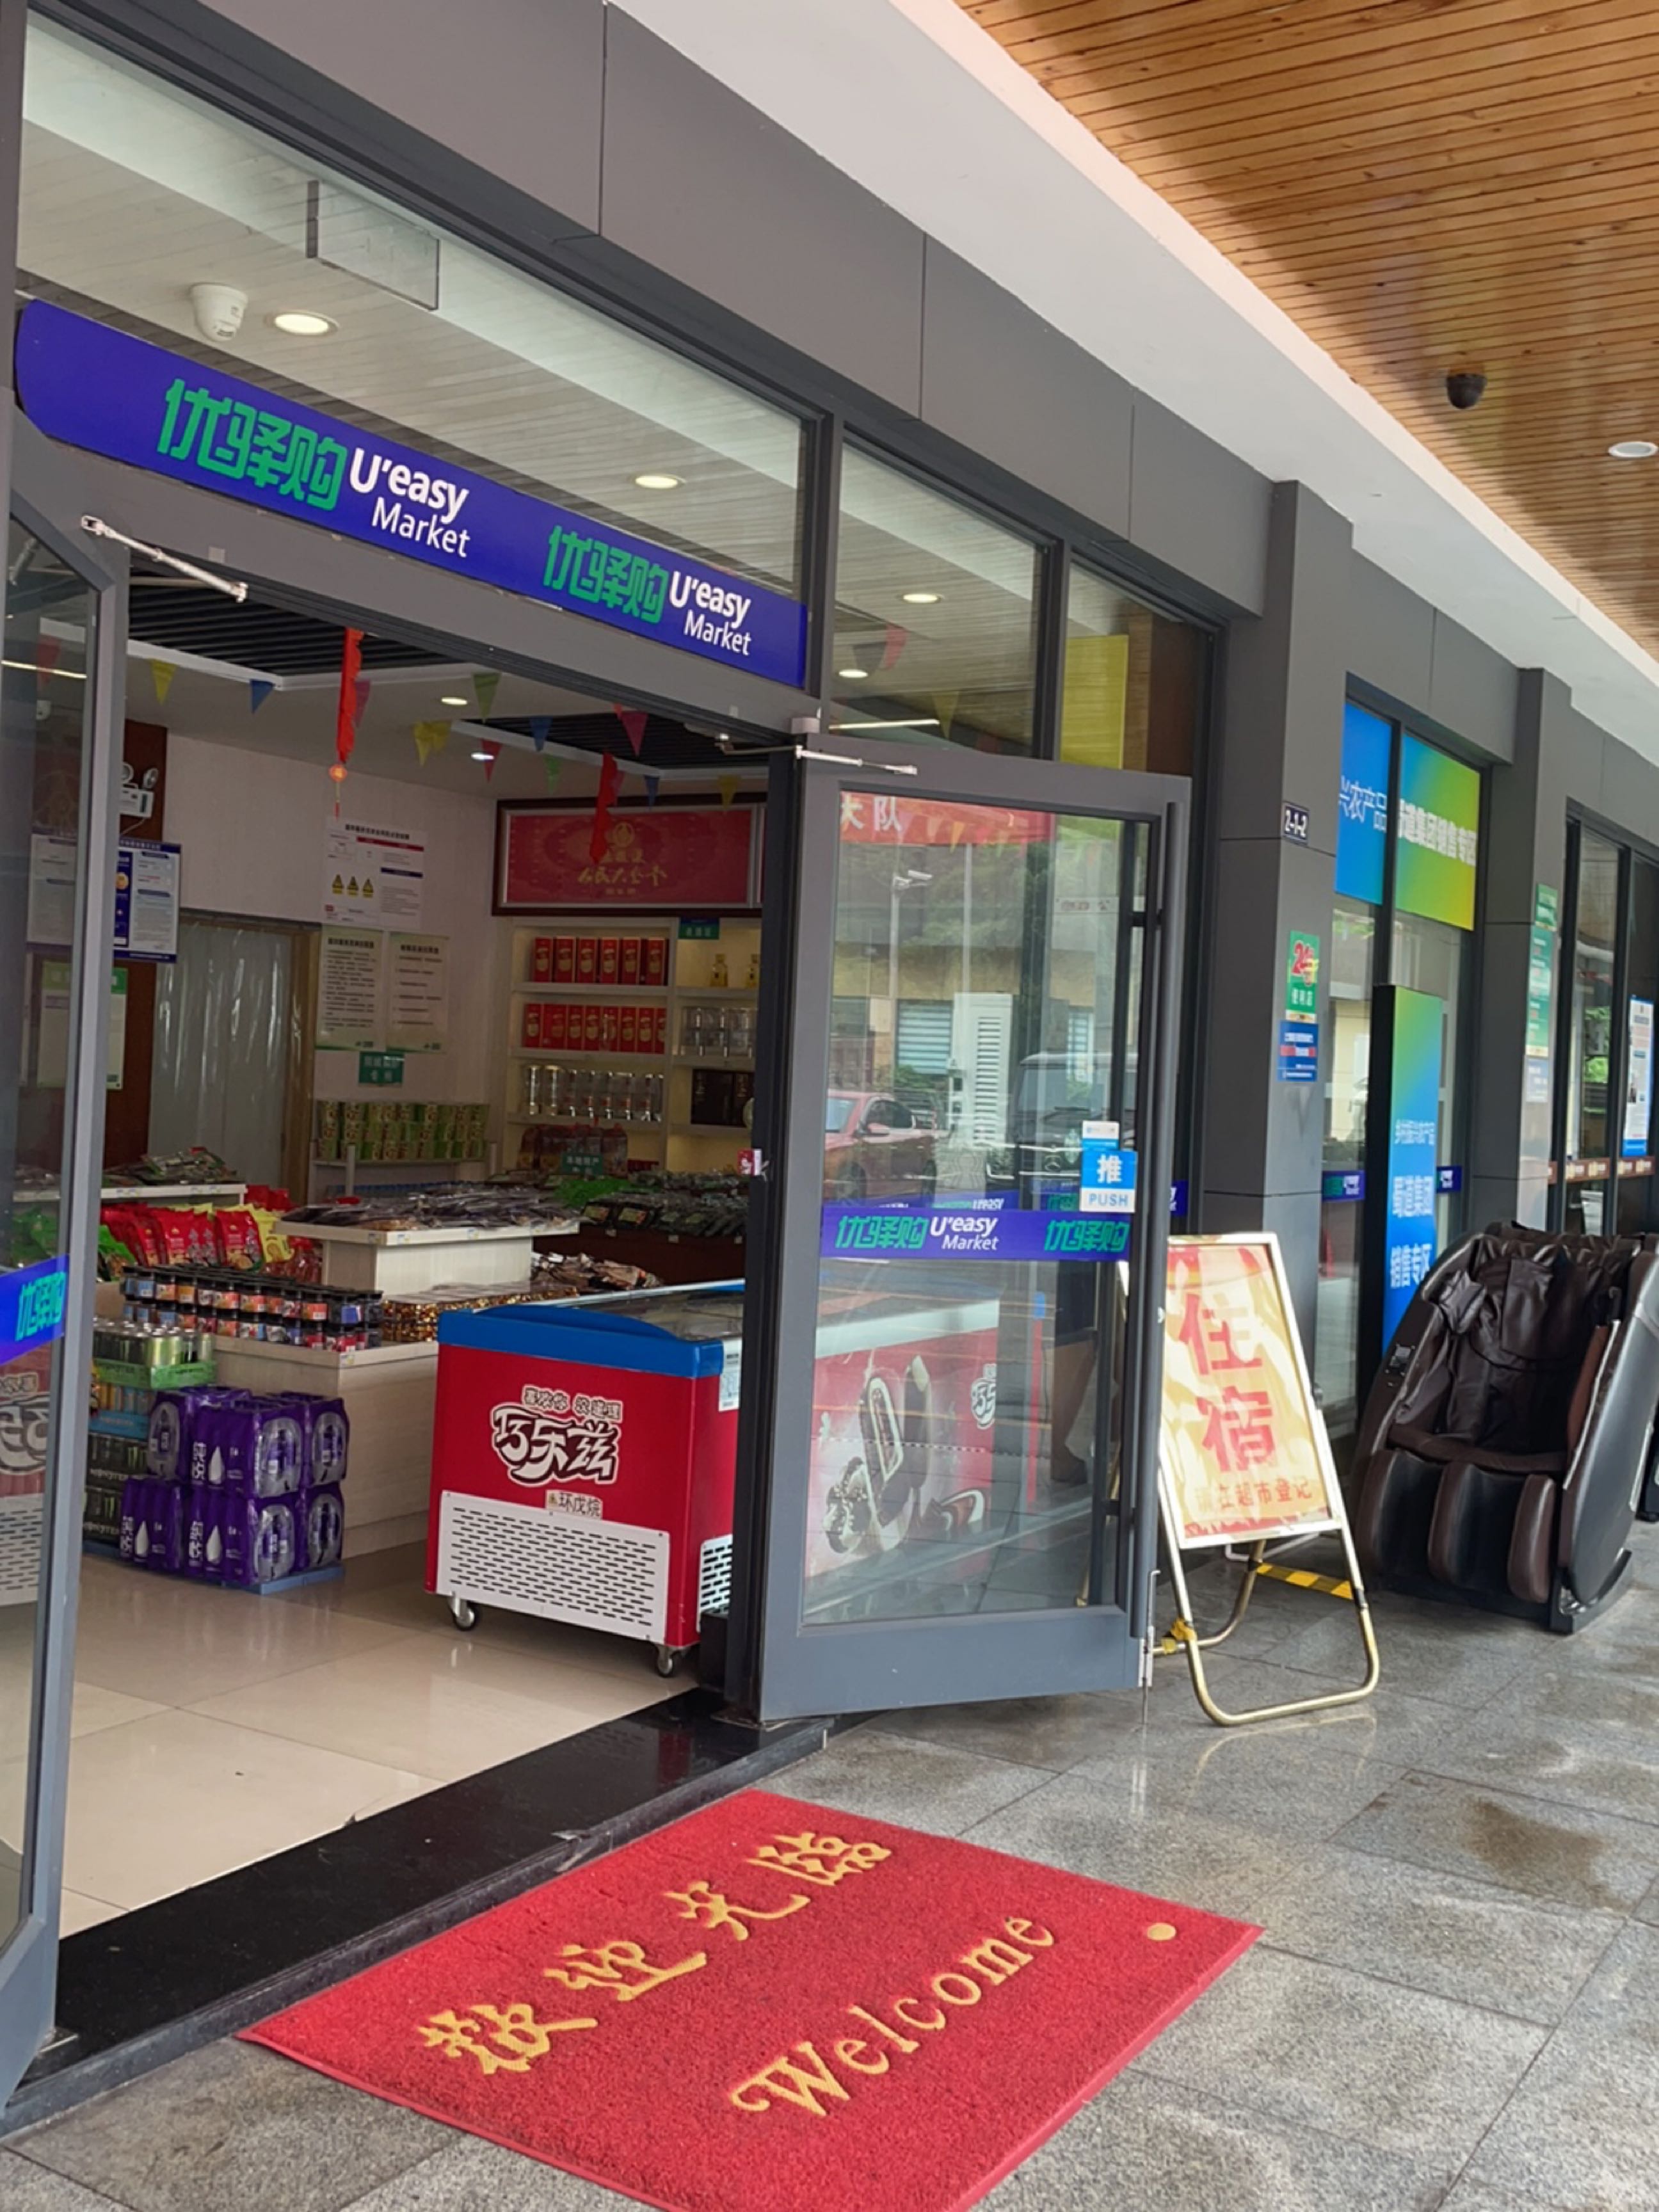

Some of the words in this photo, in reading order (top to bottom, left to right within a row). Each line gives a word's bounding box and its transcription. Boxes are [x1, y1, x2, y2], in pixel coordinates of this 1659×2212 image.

[156, 379, 348, 511] 优驿购
[349, 448, 469, 524] U'easy
[372, 496, 470, 558] Market
[543, 525, 669, 625] 优驿购
[670, 570, 751, 629] U'easy
[684, 609, 751, 655] Market
[1096, 1153, 1122, 1183] 推
[1089, 1193, 1129, 1206] PUSH
[835, 1215, 929, 1249] 优驿购
[930, 1216, 998, 1237] U'easy
[942, 1234, 1000, 1251] Market
[1044, 1219, 1131, 1253] 优驿购
[1178, 1292, 1276, 1473] 住宿
[728, 1912, 1056, 2117] Welcome
